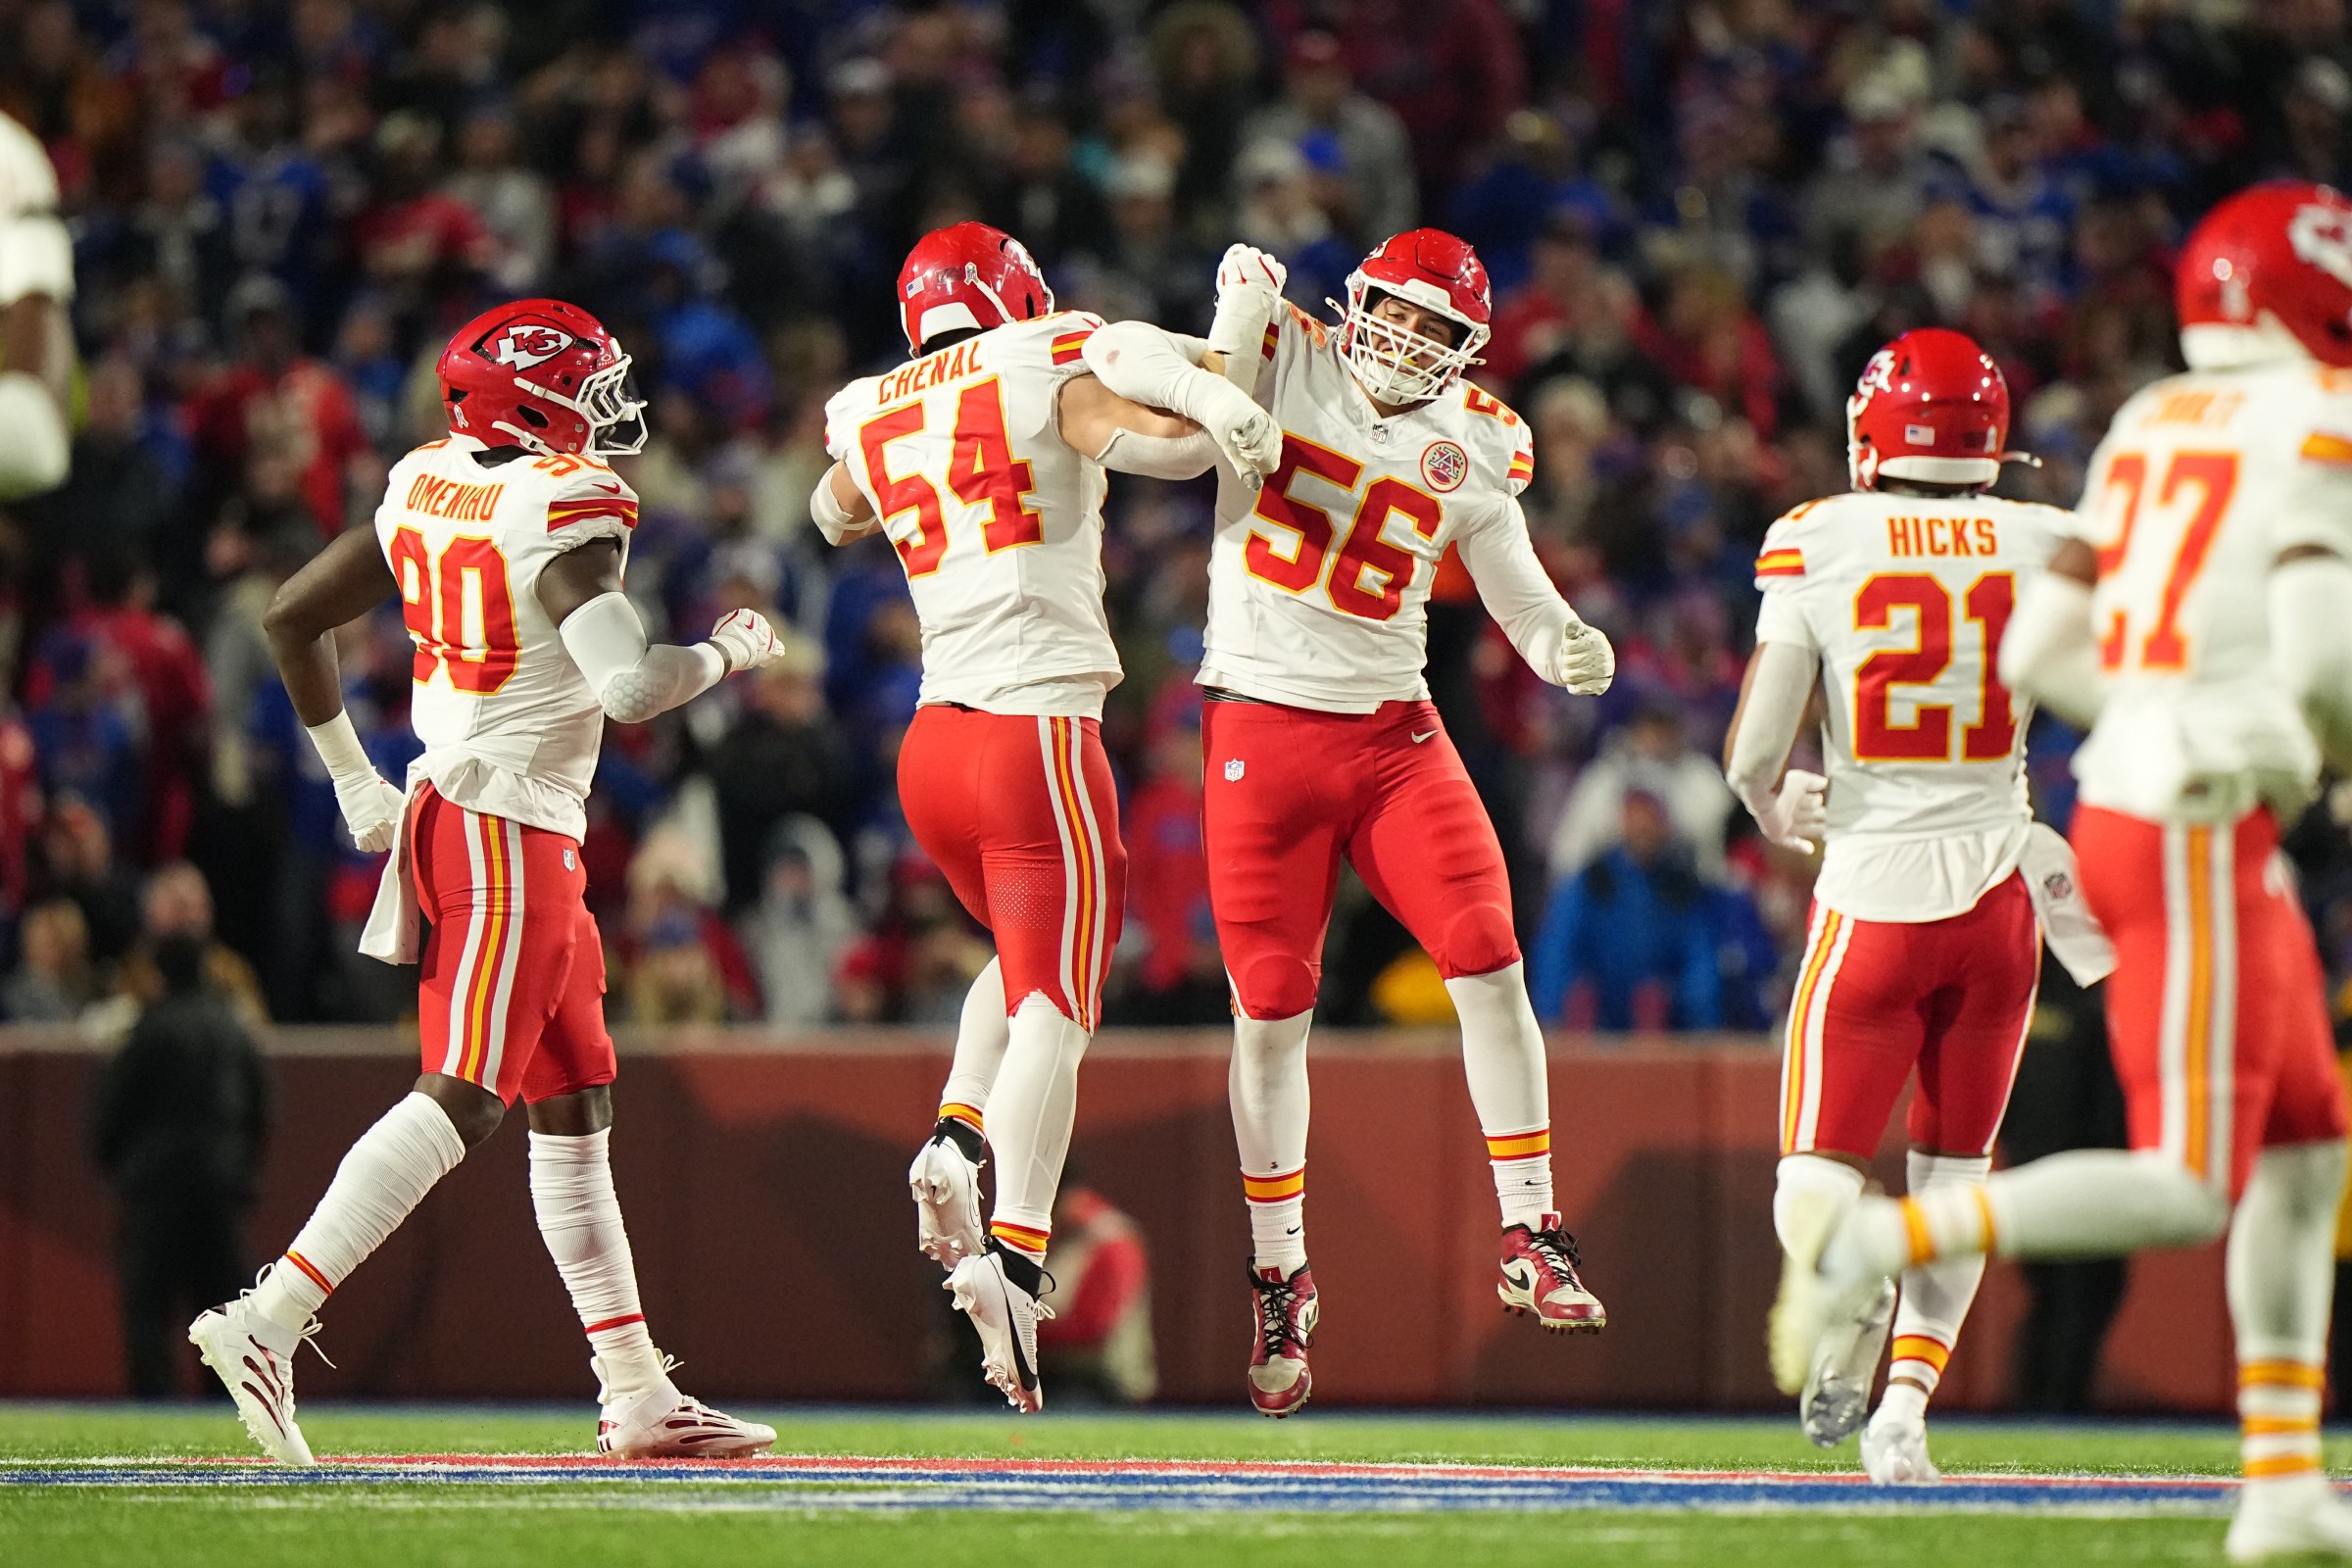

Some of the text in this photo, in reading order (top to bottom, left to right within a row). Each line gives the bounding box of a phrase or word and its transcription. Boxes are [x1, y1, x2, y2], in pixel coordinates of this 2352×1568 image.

[513, 329, 562, 356] KC
[879, 341, 983, 406] CHENAL
[858, 373, 1045, 581] 54
[1242, 429, 1443, 622] 56
[1887, 517, 1996, 557] HICKS
[390, 523, 522, 696] 90
[1852, 570, 2017, 762] 21
